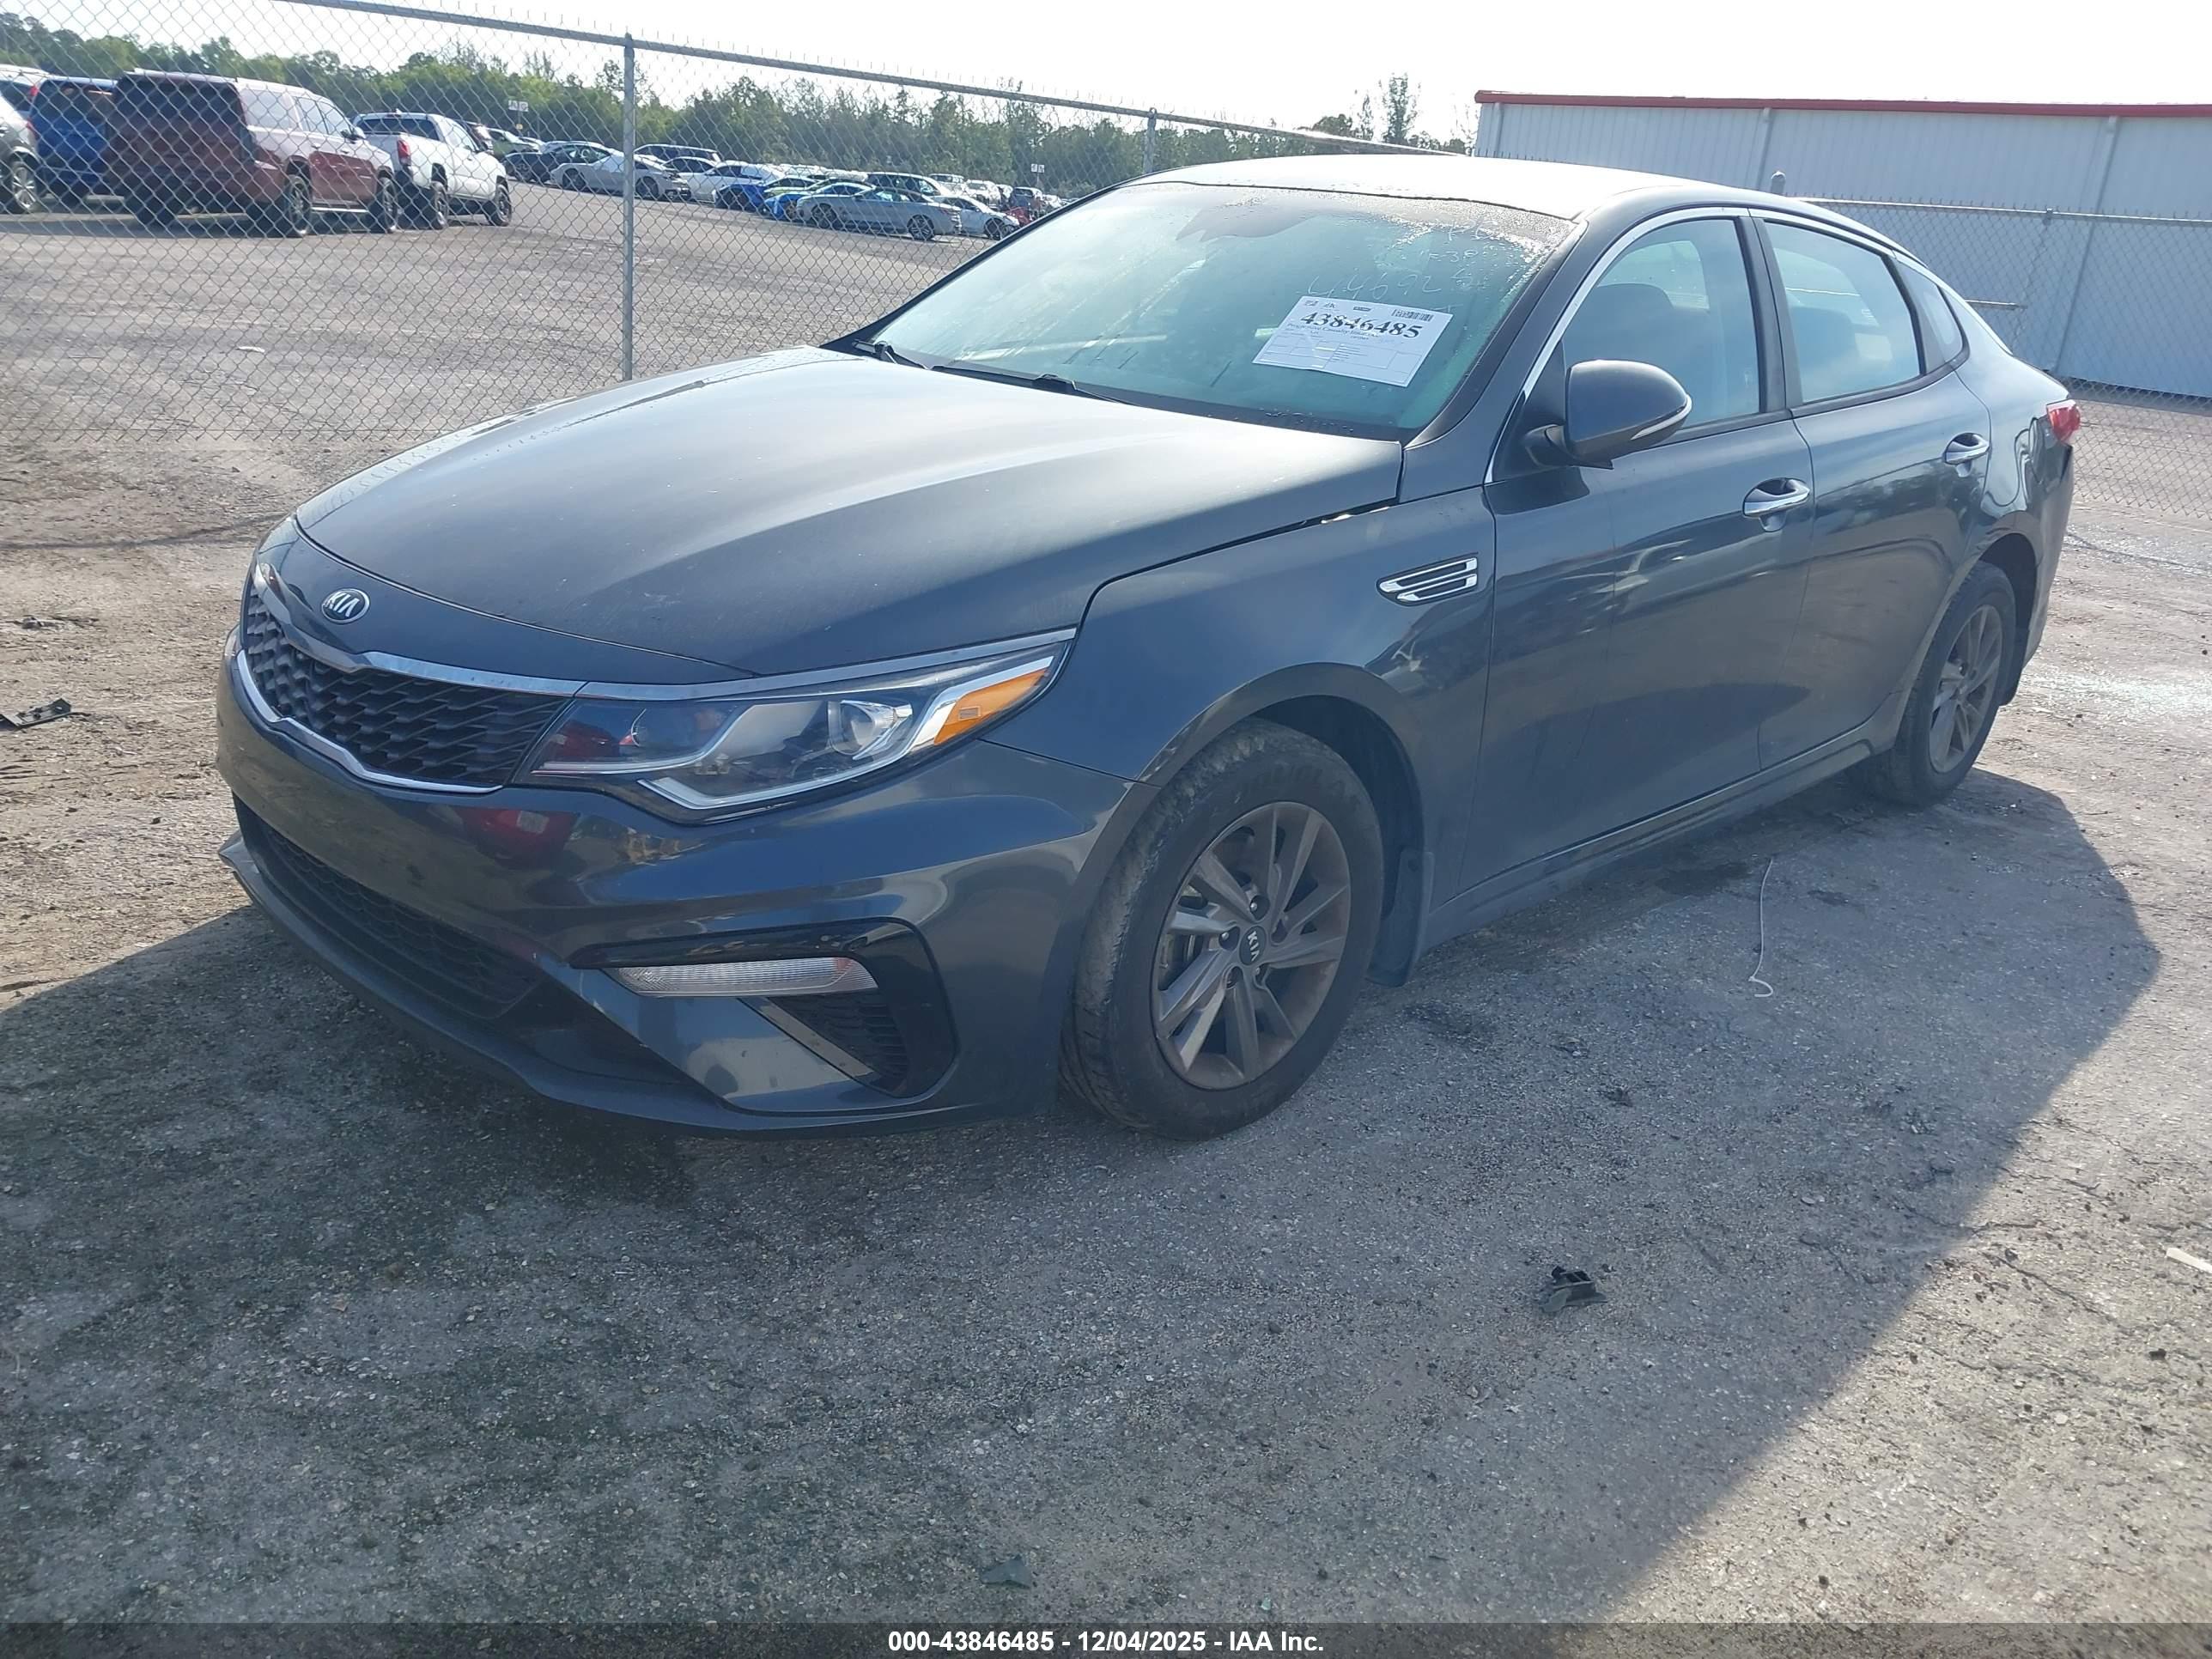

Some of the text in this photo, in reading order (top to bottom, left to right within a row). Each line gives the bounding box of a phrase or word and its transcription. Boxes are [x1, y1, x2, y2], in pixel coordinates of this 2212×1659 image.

[1300, 312, 1422, 338] 43846485
[324, 590, 361, 618] KIA
[1248, 931, 1260, 962] KIA
